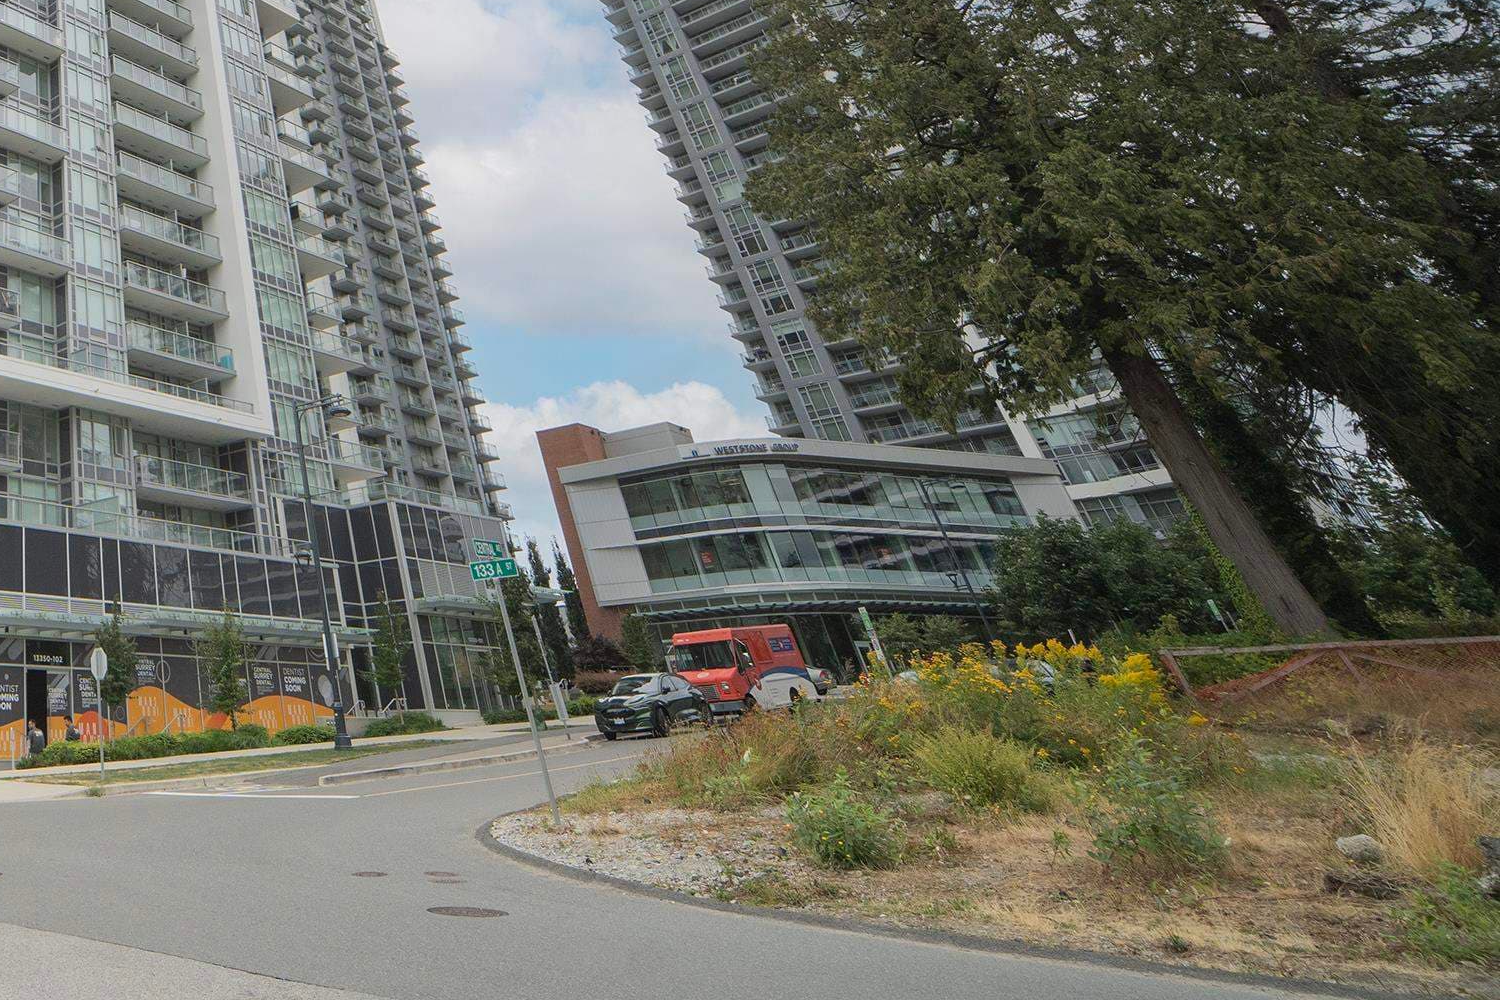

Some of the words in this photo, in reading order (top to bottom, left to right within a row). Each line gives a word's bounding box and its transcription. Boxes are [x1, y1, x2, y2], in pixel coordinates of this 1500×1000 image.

[714, 444, 767, 455] WESTSTONE
[772, 443, 799, 452] GROUP
[475, 541, 497, 556] CENTRAL
[474, 563, 495, 577] 133
[496, 562, 503, 575] A
[505, 562, 512, 570] ST
[33, 655, 63, 663] 13350-102
